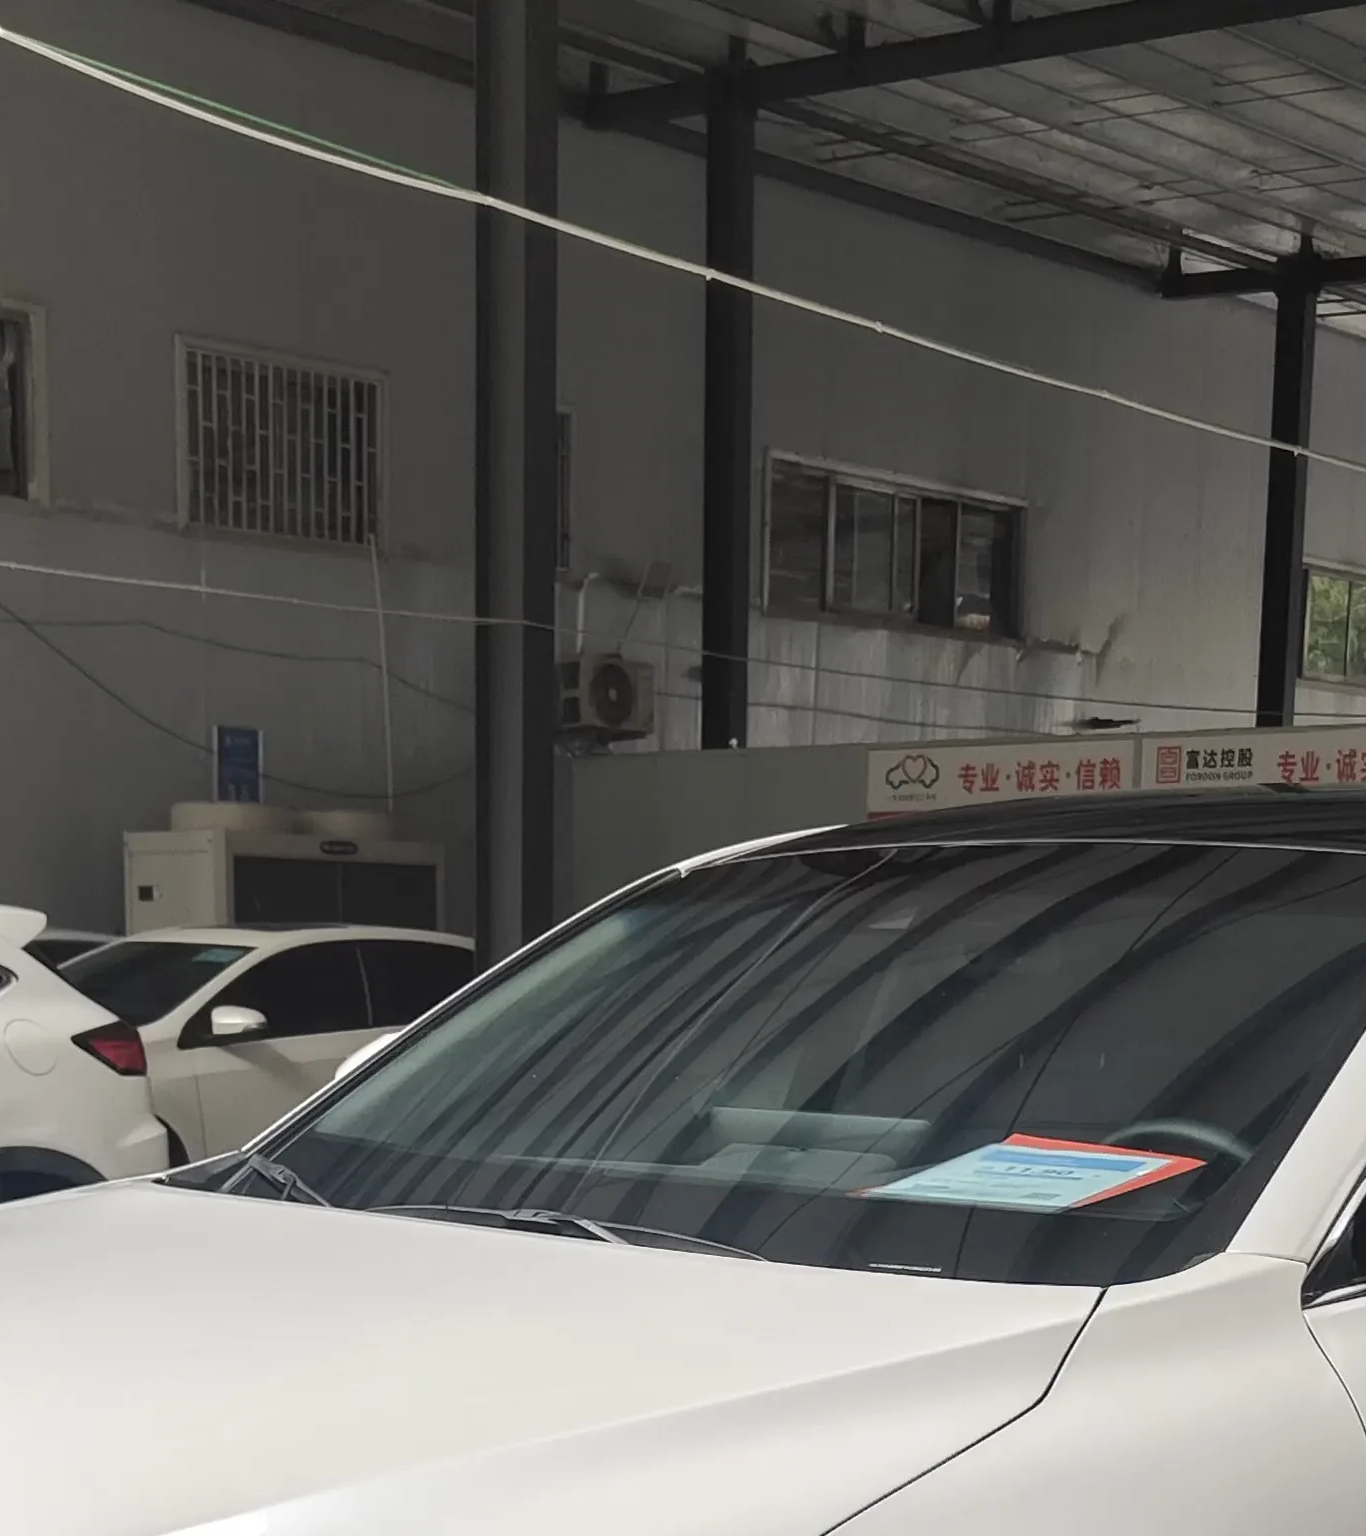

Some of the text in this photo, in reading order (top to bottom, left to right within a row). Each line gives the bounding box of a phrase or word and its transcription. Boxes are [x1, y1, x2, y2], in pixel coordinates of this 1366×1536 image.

[1185, 748, 1254, 770] 富达控股
[958, 757, 1121, 794] 专业·诚实·信赖
